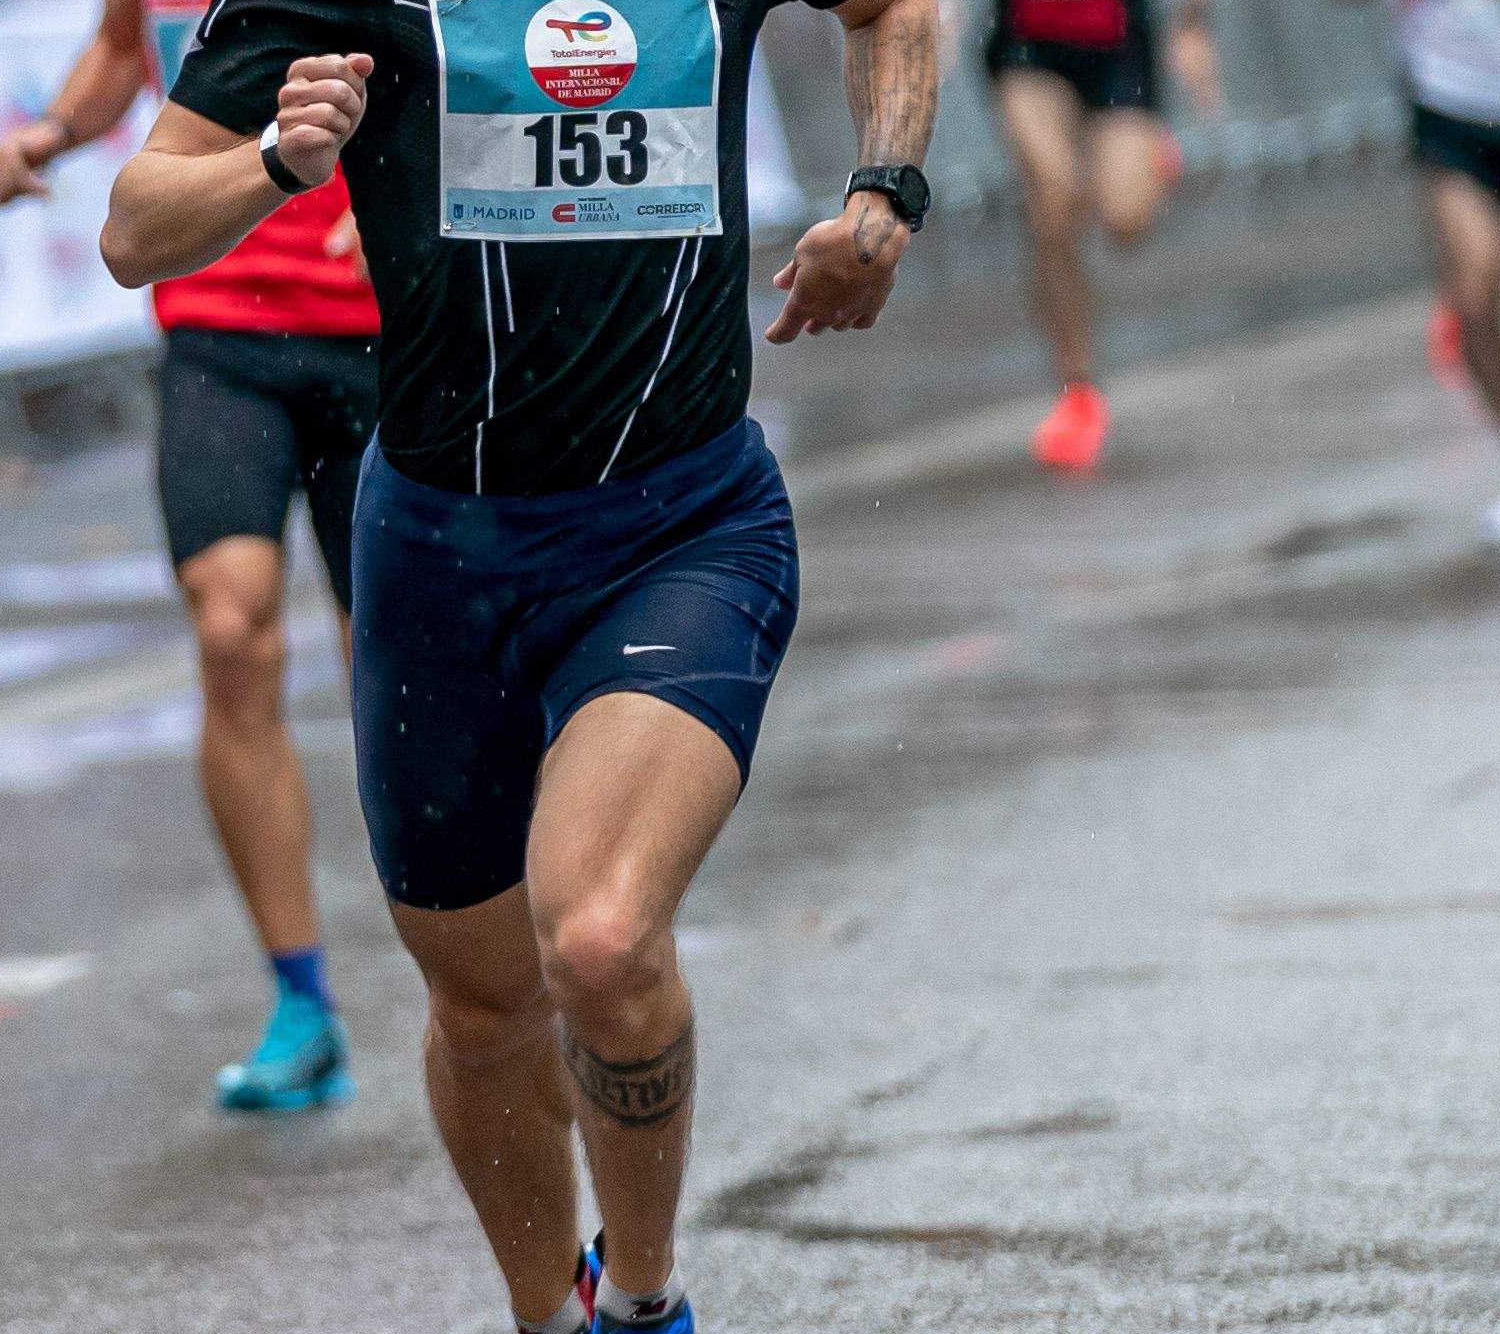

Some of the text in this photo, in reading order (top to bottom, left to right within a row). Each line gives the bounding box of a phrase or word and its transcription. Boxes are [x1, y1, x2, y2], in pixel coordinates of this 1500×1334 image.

[550, 47, 617, 59] TotalEnergies
[568, 68, 601, 78] MILLA
[545, 77, 623, 89] INTERNACIONAL
[558, 87, 612, 99] DE MADRID
[523, 110, 648, 188] 153
[473, 206, 535, 221] MADRID
[578, 202, 615, 213] MILLA
[578, 212, 620, 223] URBANA
